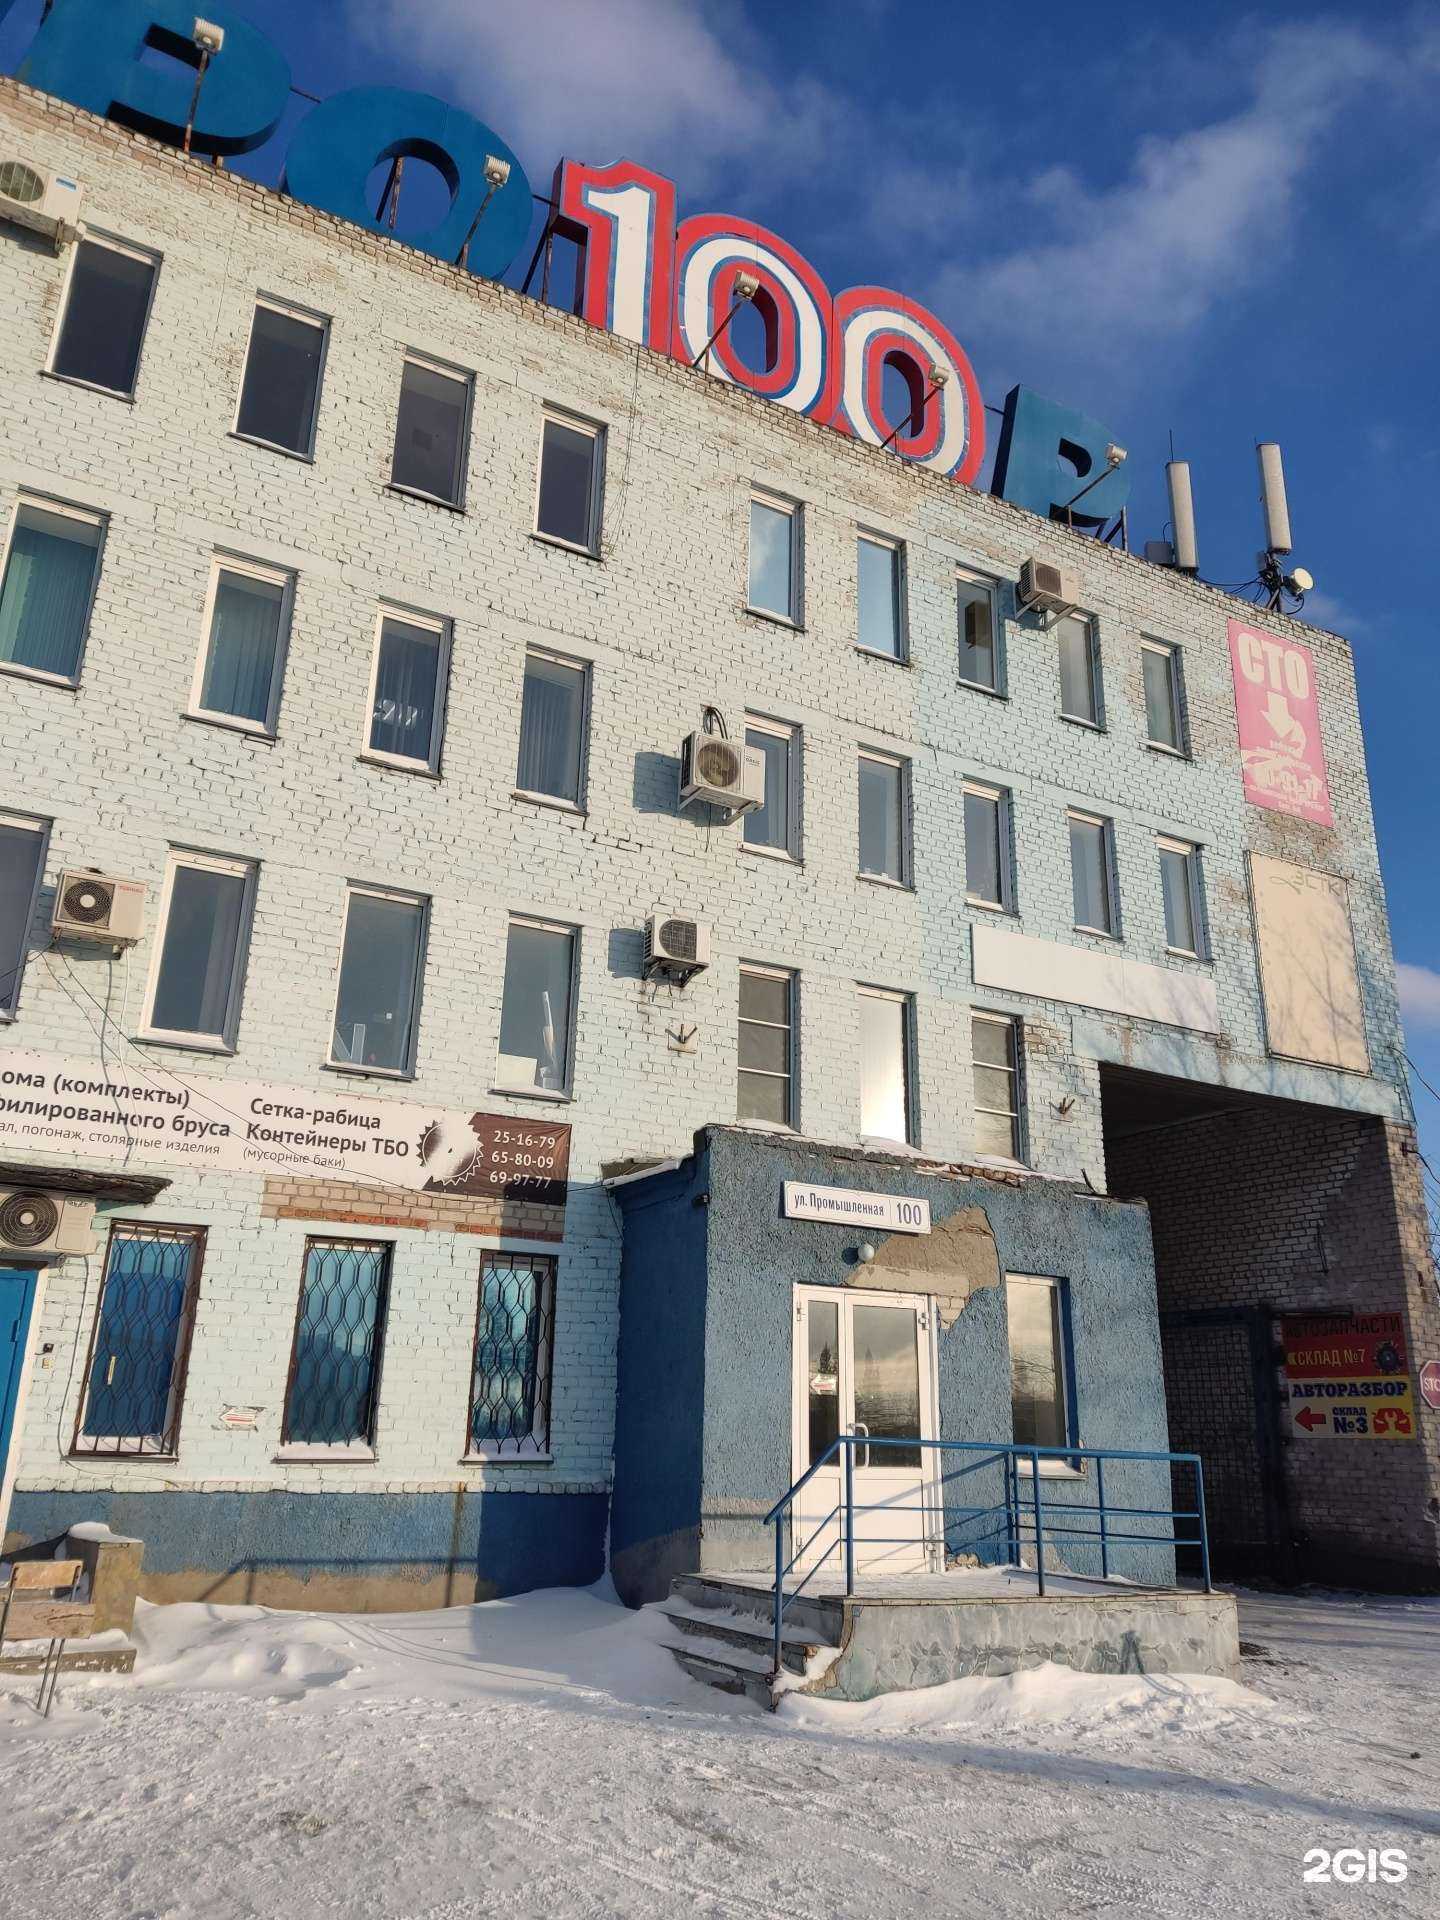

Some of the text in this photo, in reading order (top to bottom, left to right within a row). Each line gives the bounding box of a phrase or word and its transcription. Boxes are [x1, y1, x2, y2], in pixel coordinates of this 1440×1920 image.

[1238, 632, 1310, 699] СТО
[53, 1074, 190, 1110] (комплекты)
[250, 1098, 382, 1130] Сетка-рабица
[172, 1115, 230, 1138] бруса
[22, 1125, 85, 1142] погонаж,
[88, 1132, 162, 1149] столярные
[166, 1141, 221, 1155] изделия
[246, 1123, 410, 1157] Контейнеры ТБО
[494, 1130, 556, 1149] 25-16-79
[243, 1147, 347, 1169] (мусорные баки)
[491, 1151, 554, 1169] 65-80-09
[489, 1171, 552, 1189] 69-97-77
[794, 1192, 922, 1226] ул. Промышленная 100
[1297, 1351, 1342, 1367] СКЛАД
[1291, 1381, 1409, 1398] АВТОРАЗБОР
[1332, 1406, 1368, 1416] СКЛАД
